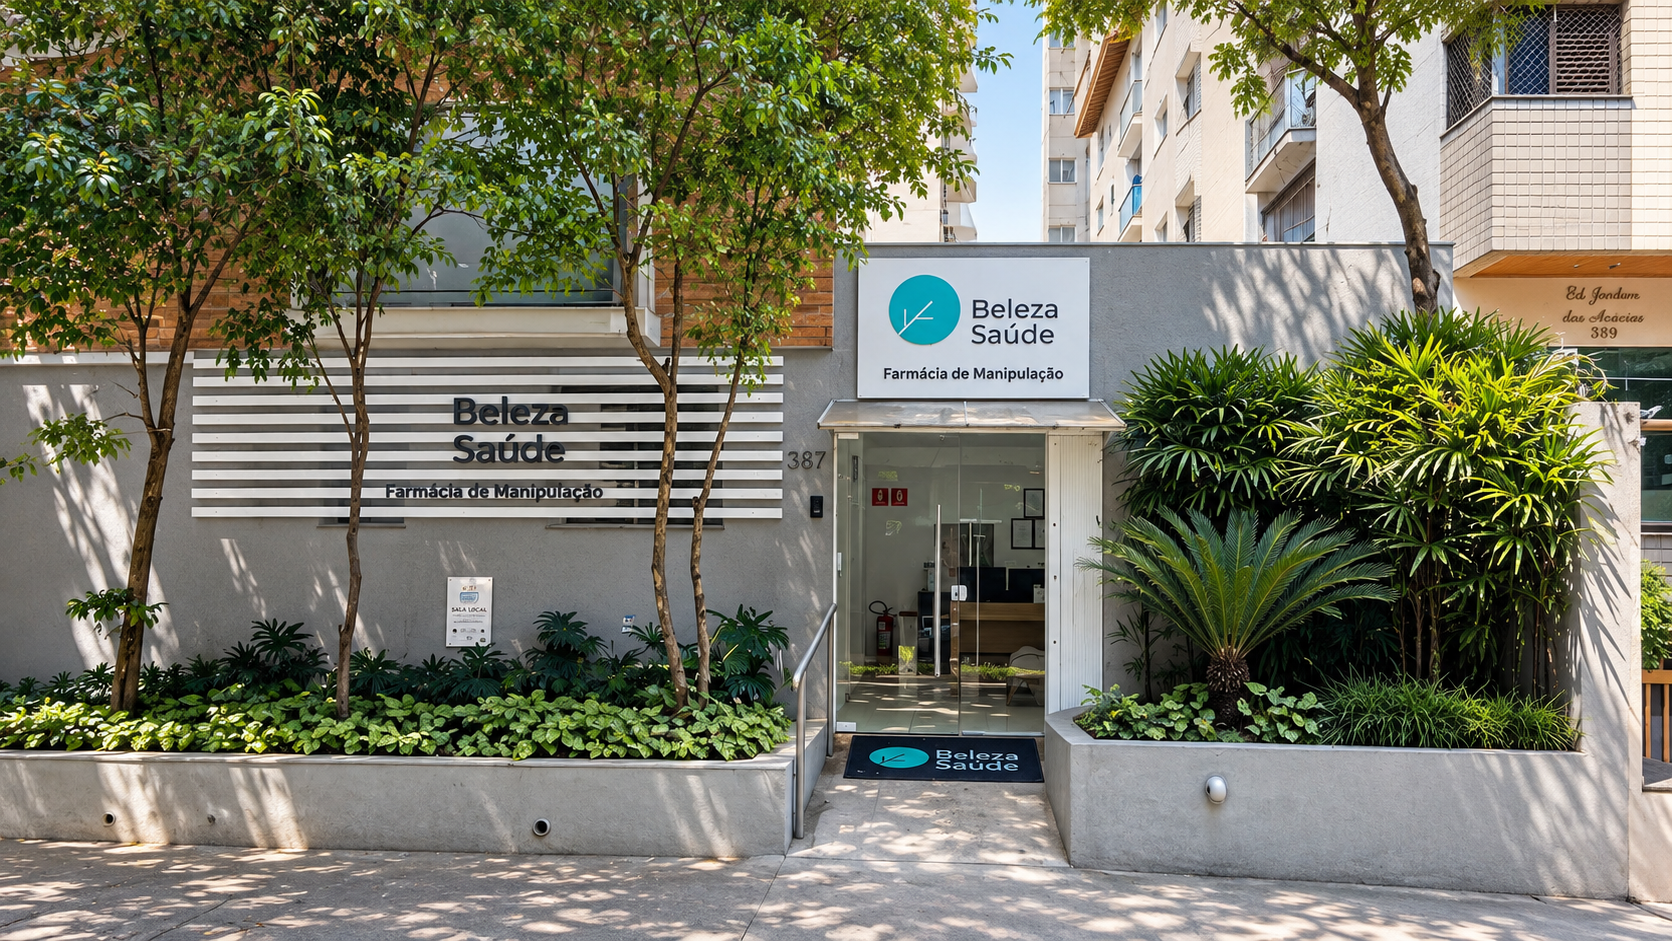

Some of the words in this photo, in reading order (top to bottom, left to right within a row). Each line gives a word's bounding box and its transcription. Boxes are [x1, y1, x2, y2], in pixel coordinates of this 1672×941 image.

[1566, 285, 1586, 300] Ed
[972, 299, 1058, 319] Beleza
[1562, 309, 1585, 323] das
[971, 323, 1055, 345] Saúde
[1590, 326, 1618, 339] 389
[883, 367, 948, 380] Farmácia
[951, 367, 970, 380] de
[973, 367, 1064, 383] Manipulação
[453, 396, 569, 426] Beleza
[452, 433, 566, 463] Saúde
[787, 450, 827, 470] 387
[385, 483, 463, 499] Farmácia
[467, 483, 490, 499] de
[494, 483, 604, 503] Manipulação
[936, 749, 1018, 760] Beleza
[935, 759, 1018, 771] Saúde
